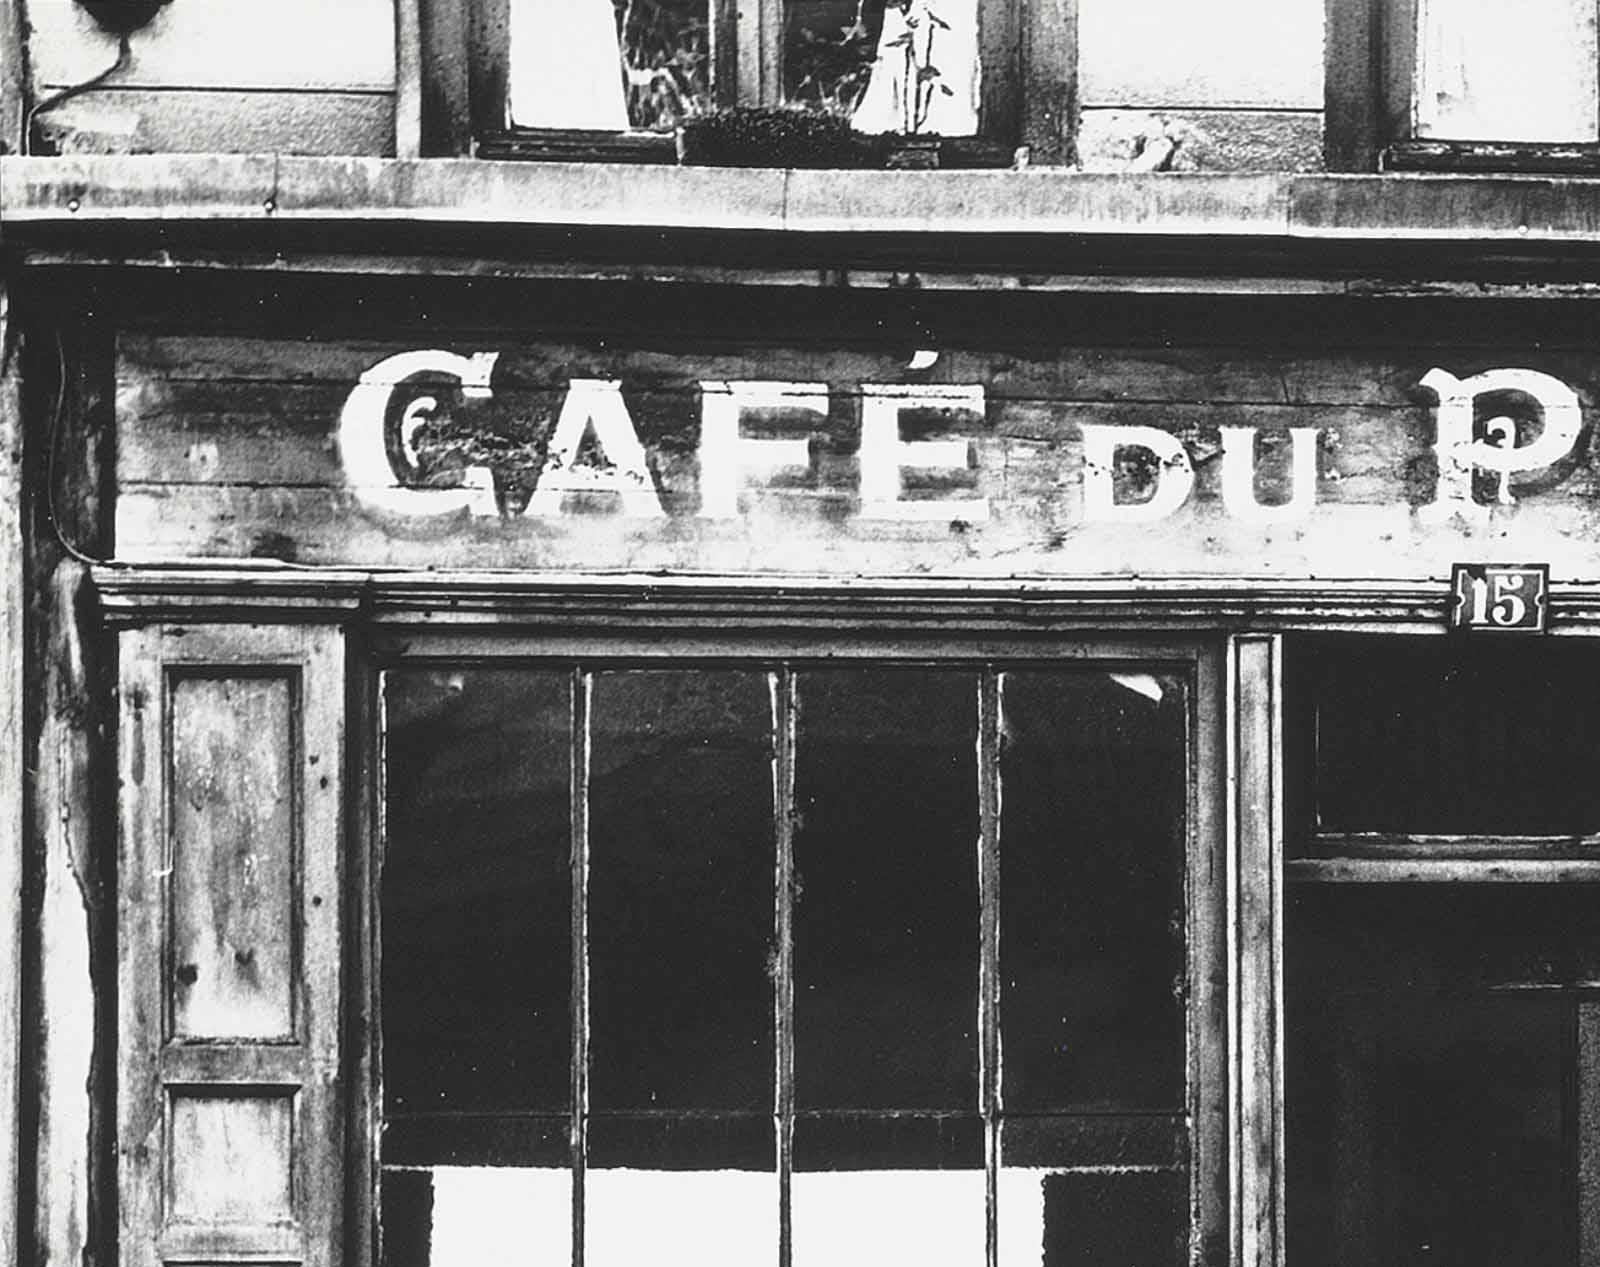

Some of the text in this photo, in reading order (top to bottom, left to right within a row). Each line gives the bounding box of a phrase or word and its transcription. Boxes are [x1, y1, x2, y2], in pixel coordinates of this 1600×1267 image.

[339, 349, 989, 522] CAFÉ
[1080, 425, 1321, 524] DU
[1469, 574, 1526, 626] 15
